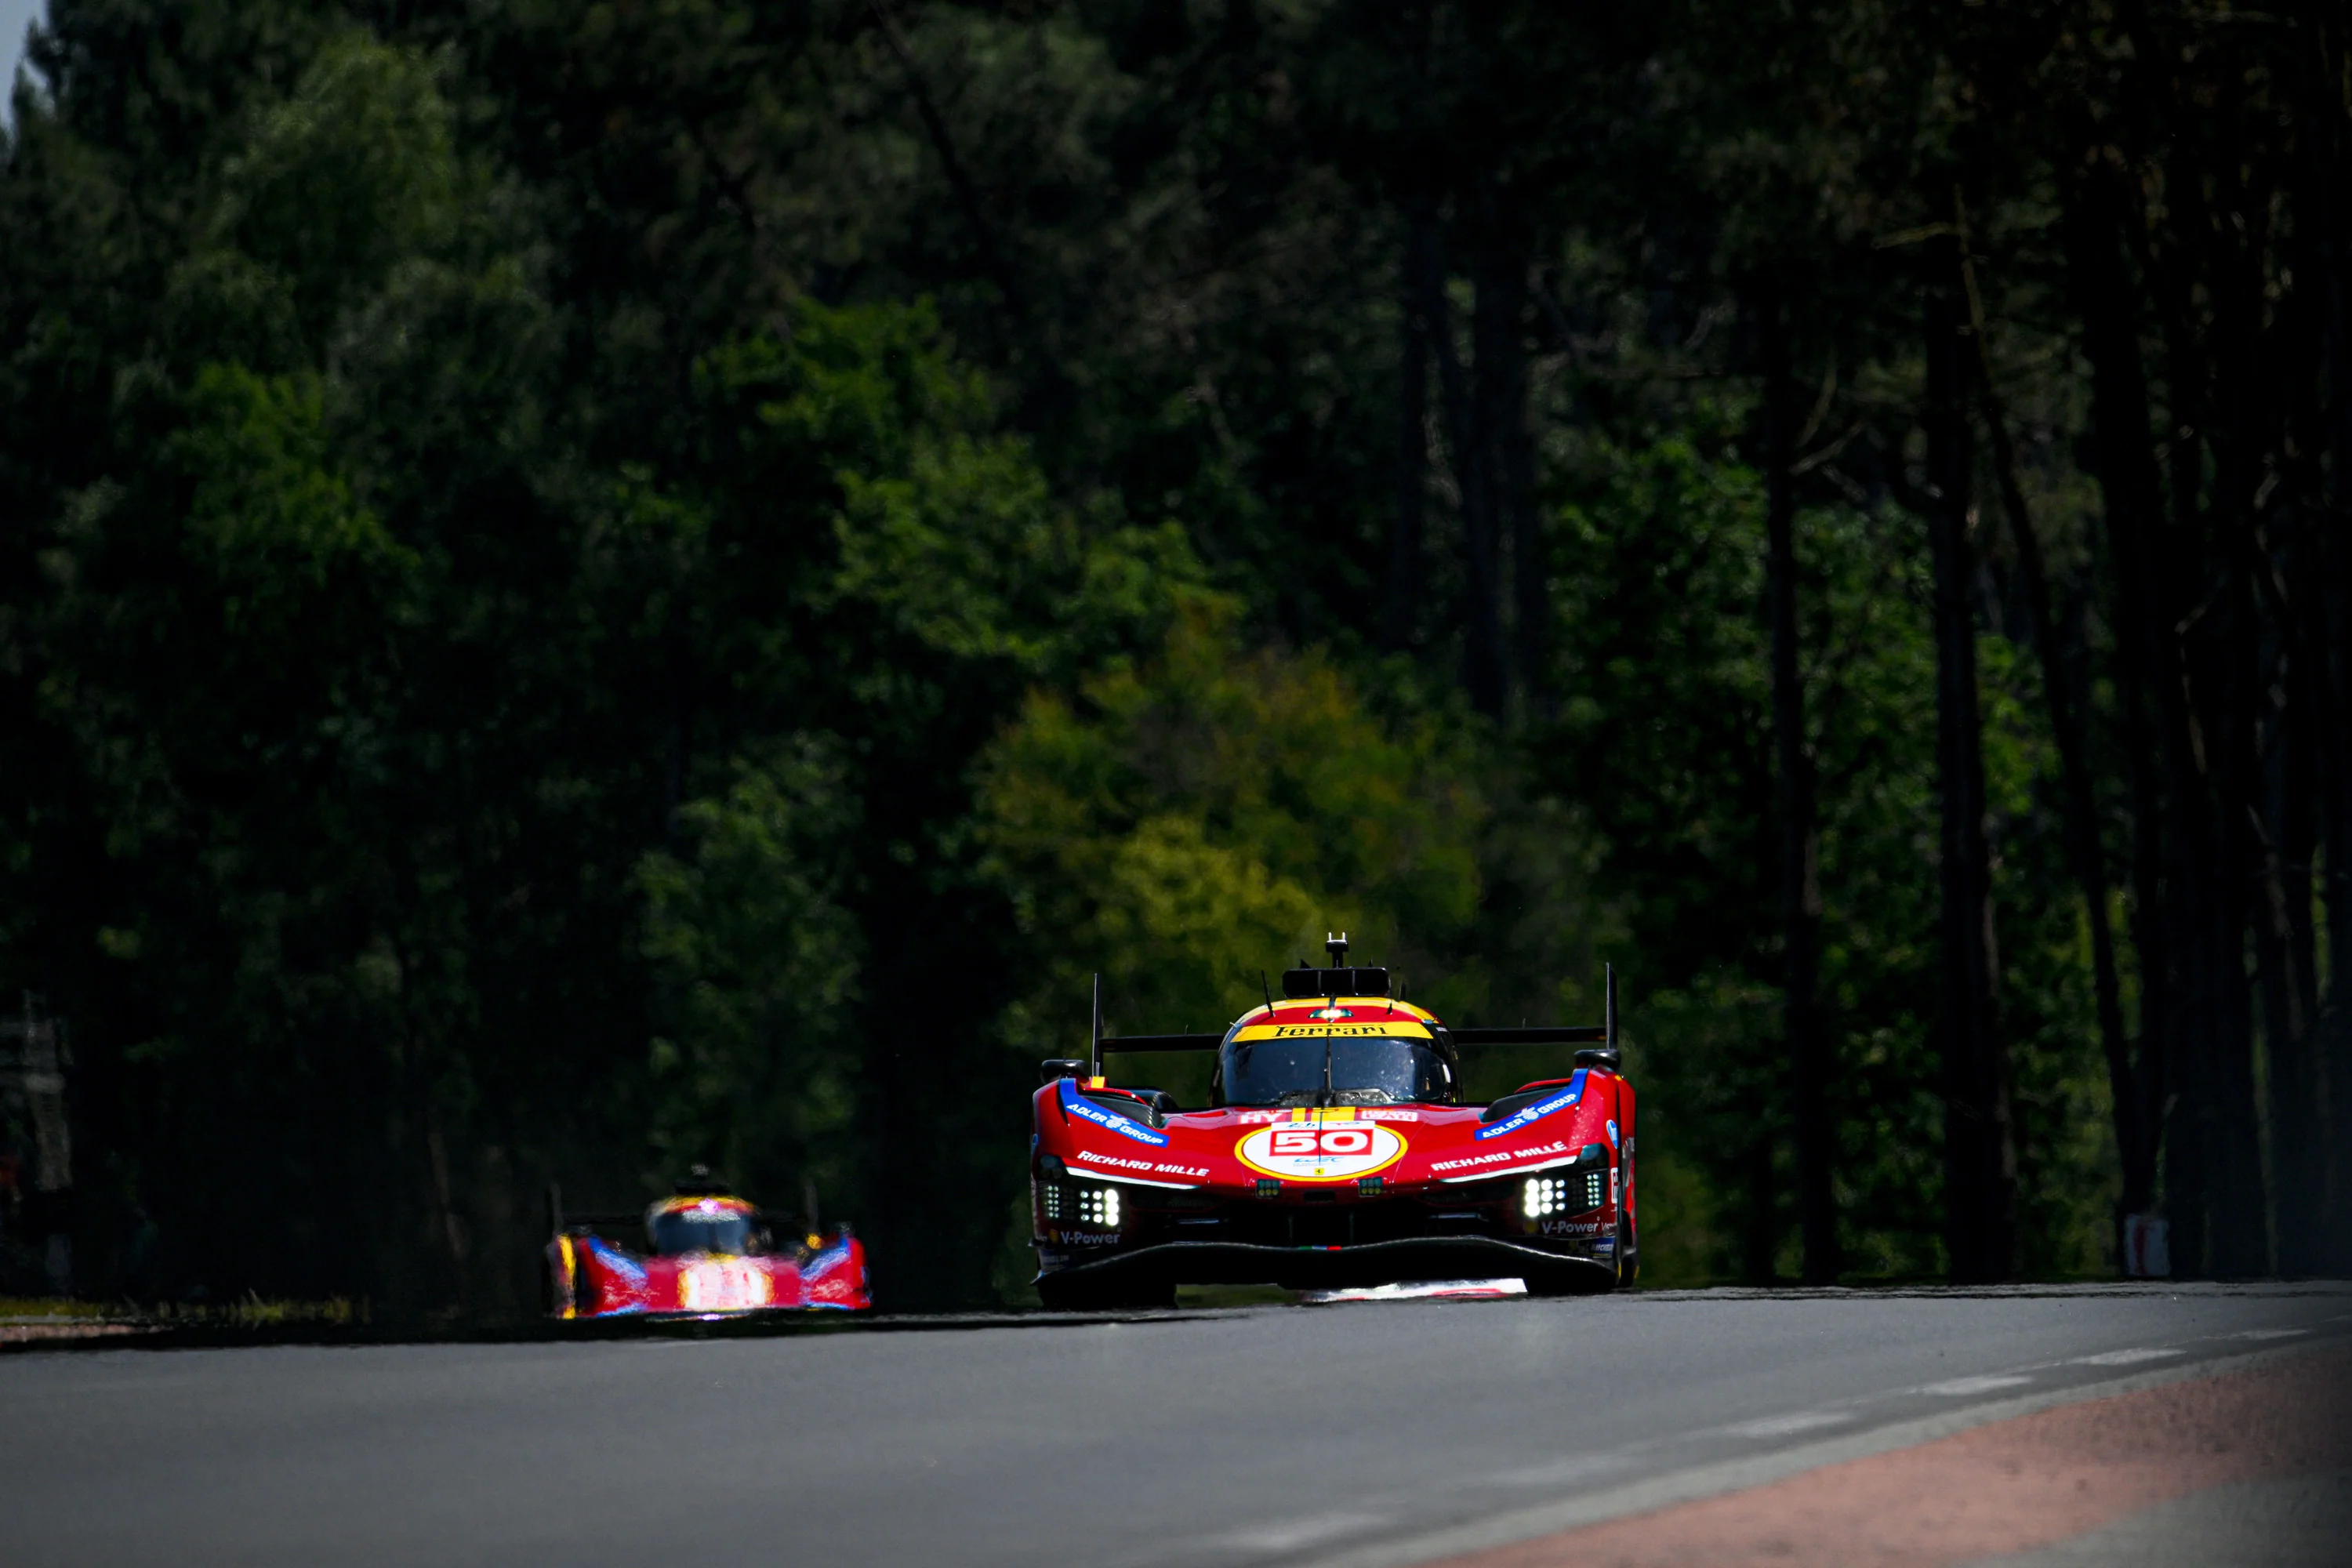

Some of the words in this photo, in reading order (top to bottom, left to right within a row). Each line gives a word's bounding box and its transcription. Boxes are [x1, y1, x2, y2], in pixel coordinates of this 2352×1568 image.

[1272, 1024, 1389, 1037] Ferrari
[1066, 1103, 1108, 1123] ADLER
[1120, 1125, 1163, 1145] GROUP
[1482, 1118, 1526, 1138] ADLER
[1537, 1093, 1577, 1114] GROUP
[1274, 1131, 1368, 1152] 50
[1077, 1150, 1153, 1171] RICHARD
[1154, 1163, 1210, 1177] MILLE
[1430, 1152, 1512, 1171] RICHARD
[1513, 1141, 1567, 1159] MILLE
[1061, 1231, 1120, 1245] V-Power
[1541, 1220, 1598, 1234] V-Power
